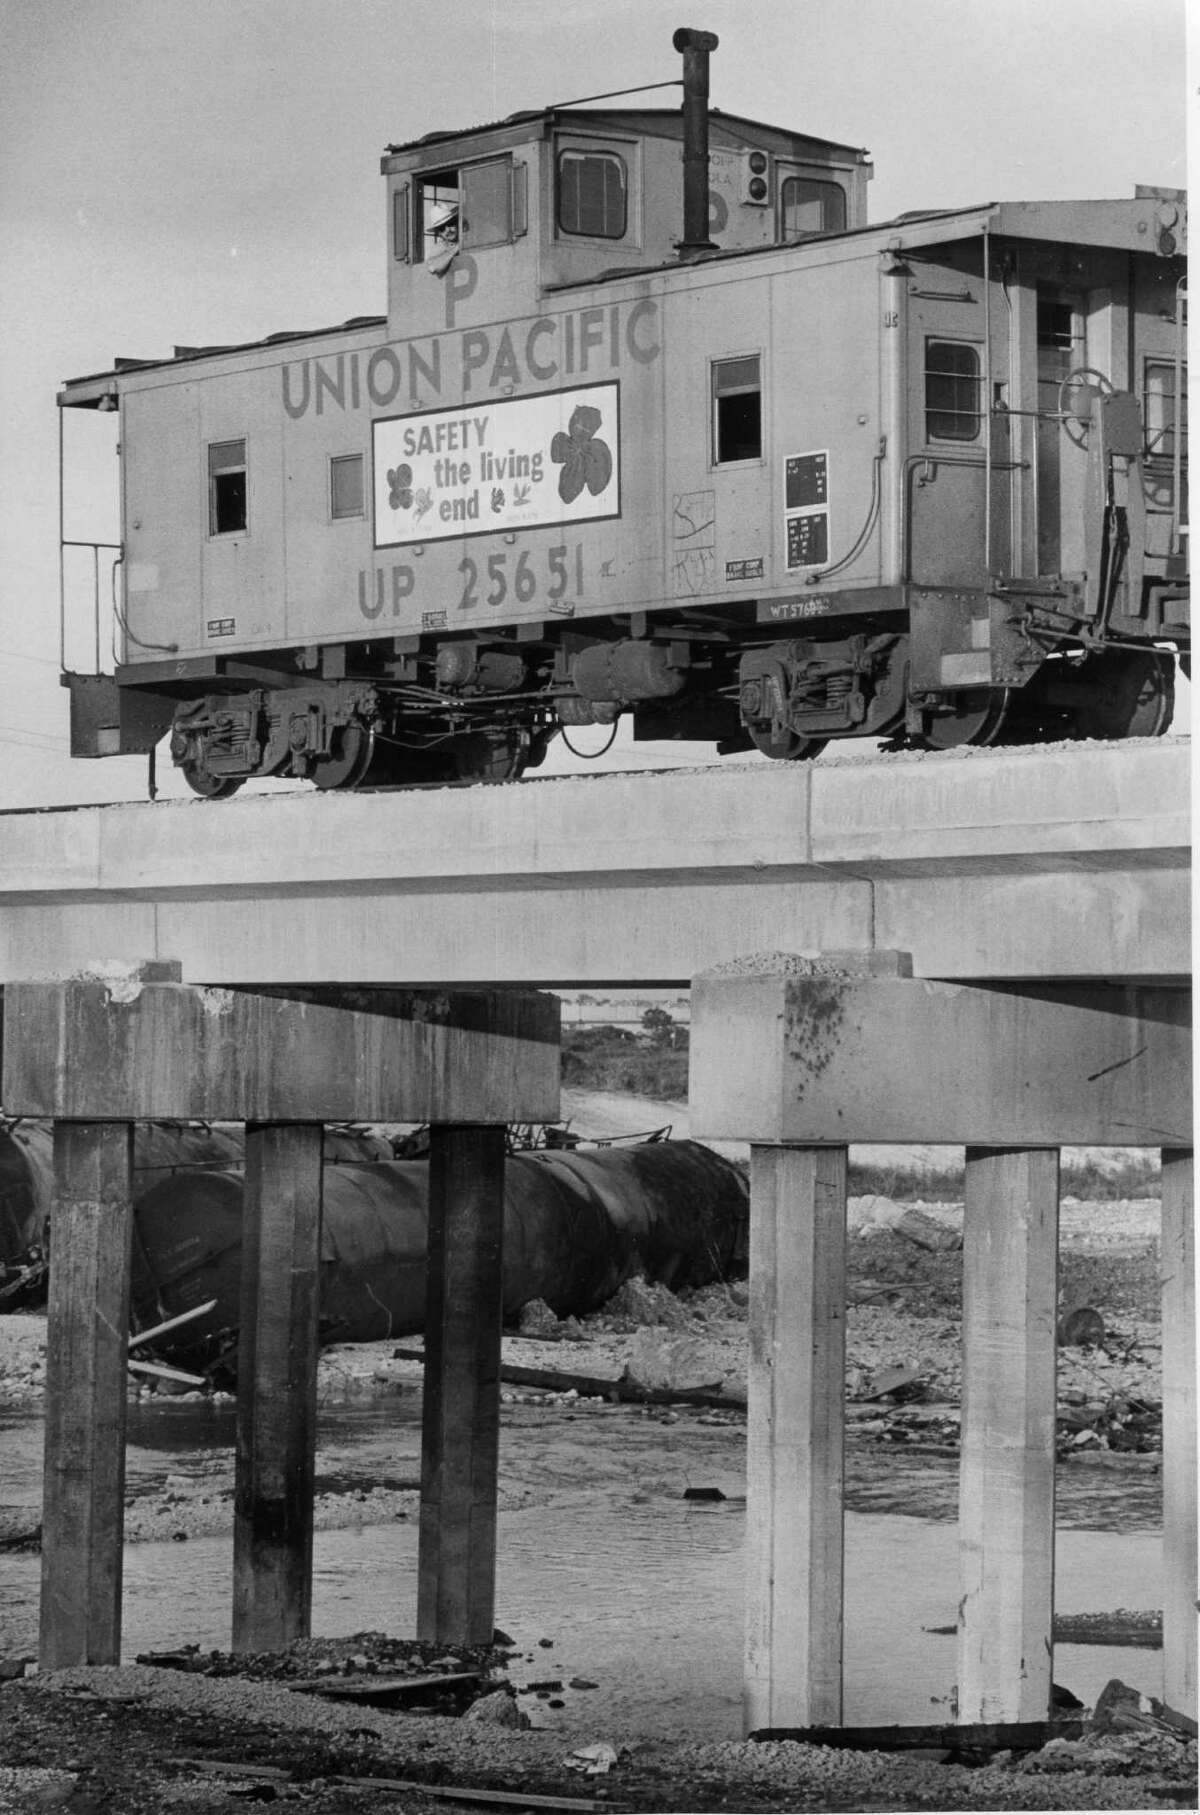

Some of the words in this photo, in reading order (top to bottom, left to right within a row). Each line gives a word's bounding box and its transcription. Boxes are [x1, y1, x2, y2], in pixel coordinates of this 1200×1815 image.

[282, 339, 441, 419] UNION
[462, 301, 661, 392] PACIFIC
[403, 416, 489, 457] SAFETY
[434, 459, 471, 488] the
[480, 450, 544, 483] living
[439, 490, 480, 522] end
[358, 566, 415, 620] UP
[457, 543, 585, 610] 25651
